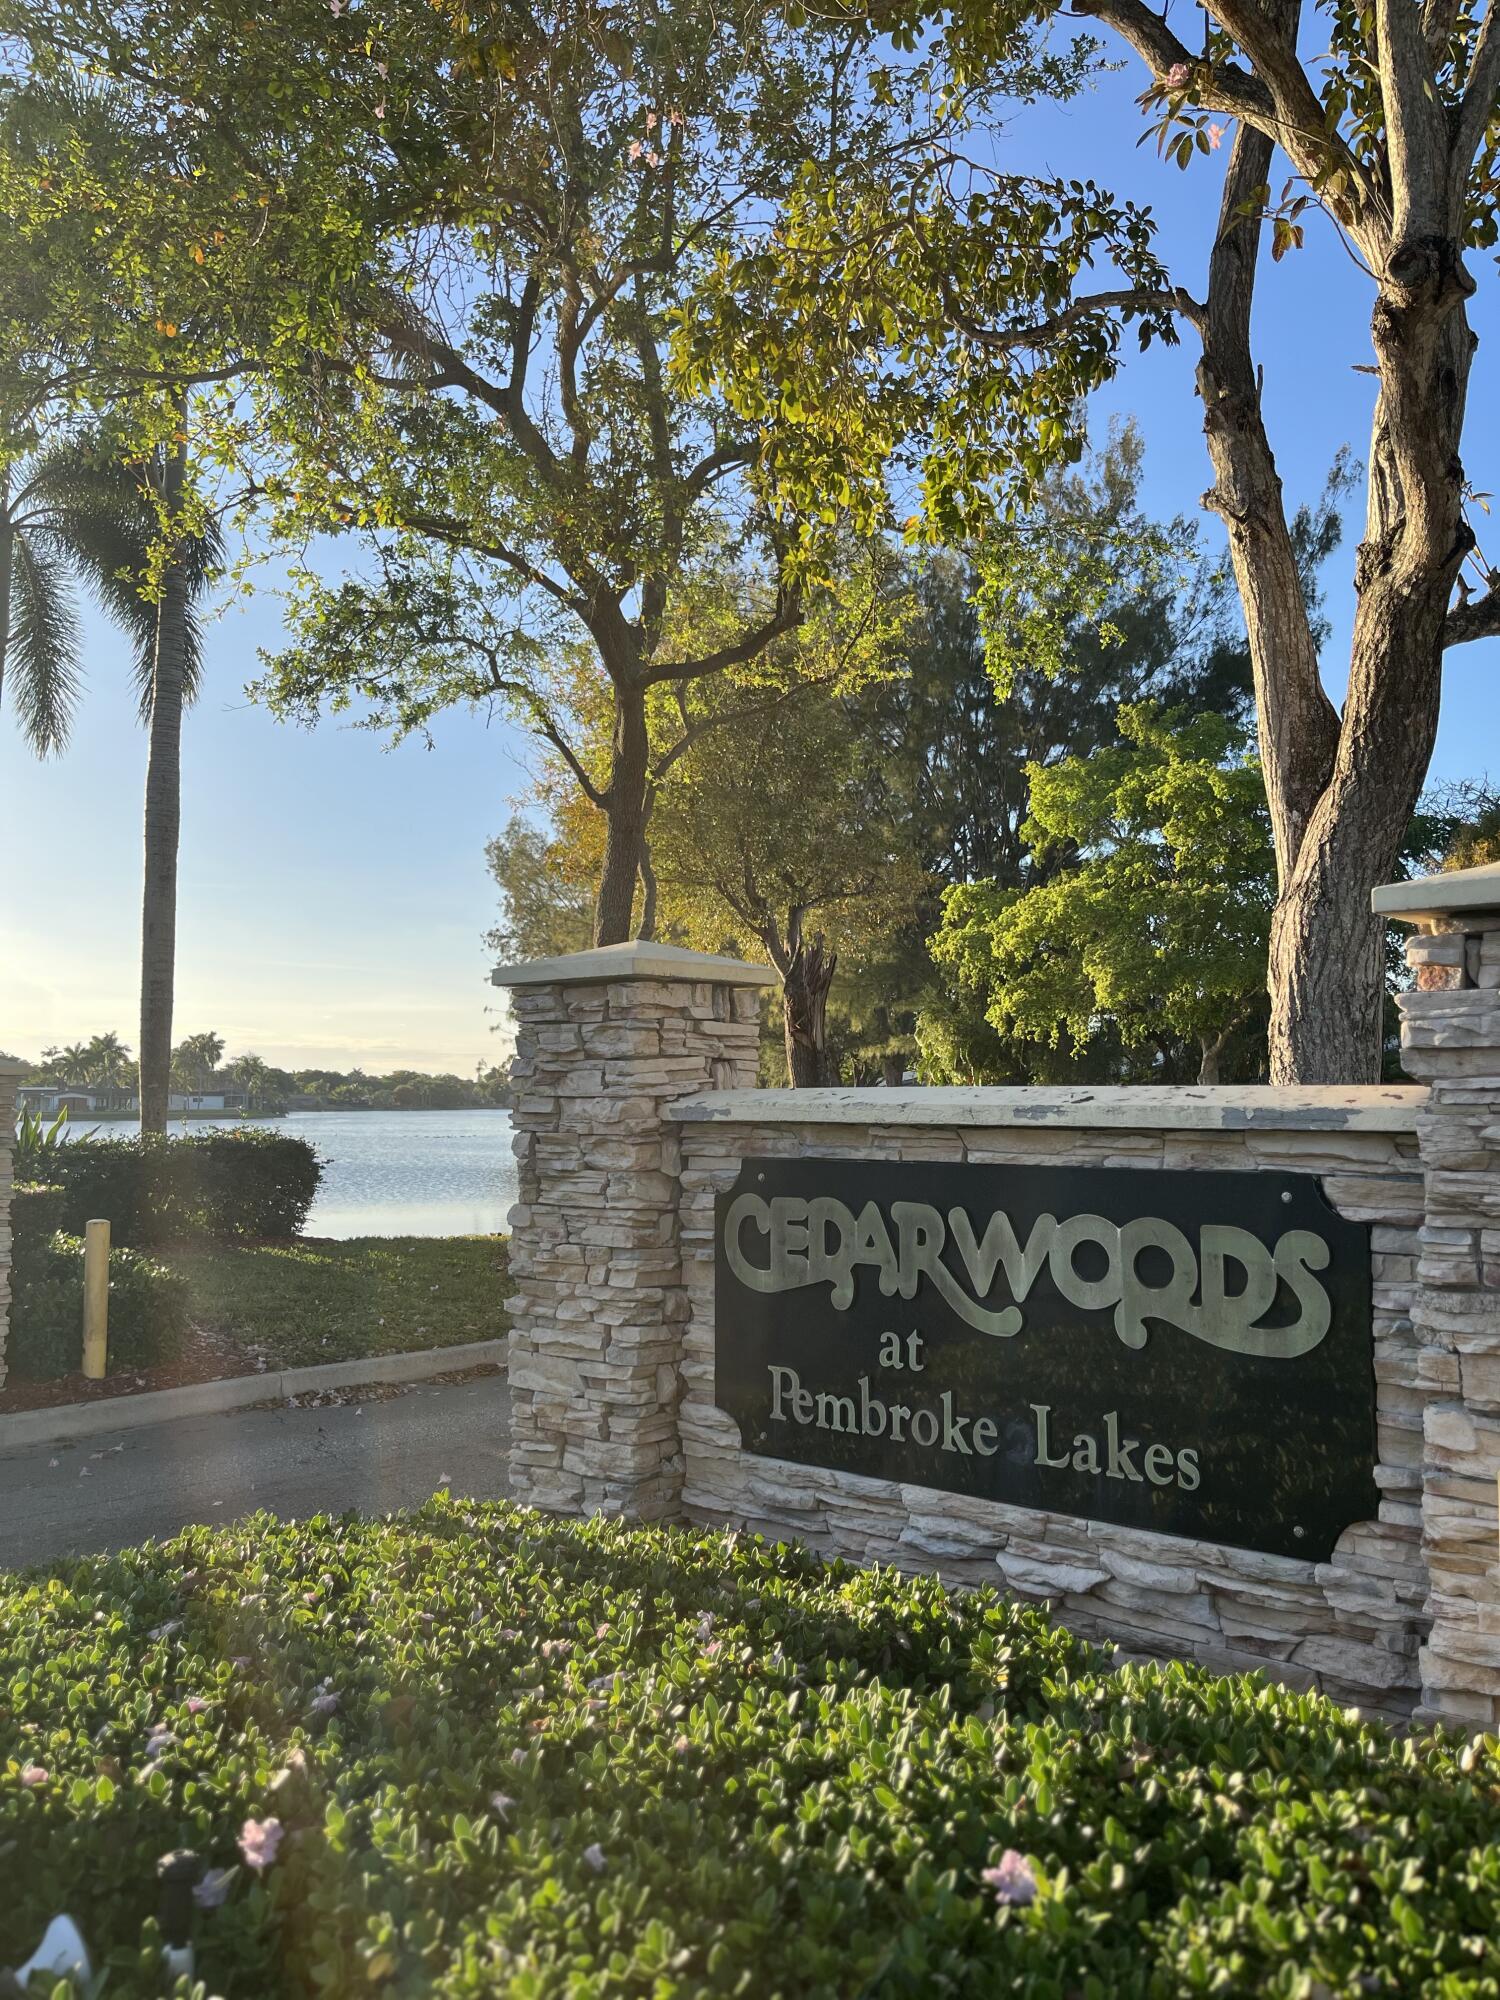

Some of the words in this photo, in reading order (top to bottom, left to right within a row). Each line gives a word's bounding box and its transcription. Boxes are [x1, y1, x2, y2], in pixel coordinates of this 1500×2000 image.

[724, 1192, 1332, 1359] CEDARWOODS
[878, 1328, 926, 1372] at
[767, 1365, 999, 1457] Pembroke
[1029, 1403, 1201, 1492] Lakes
